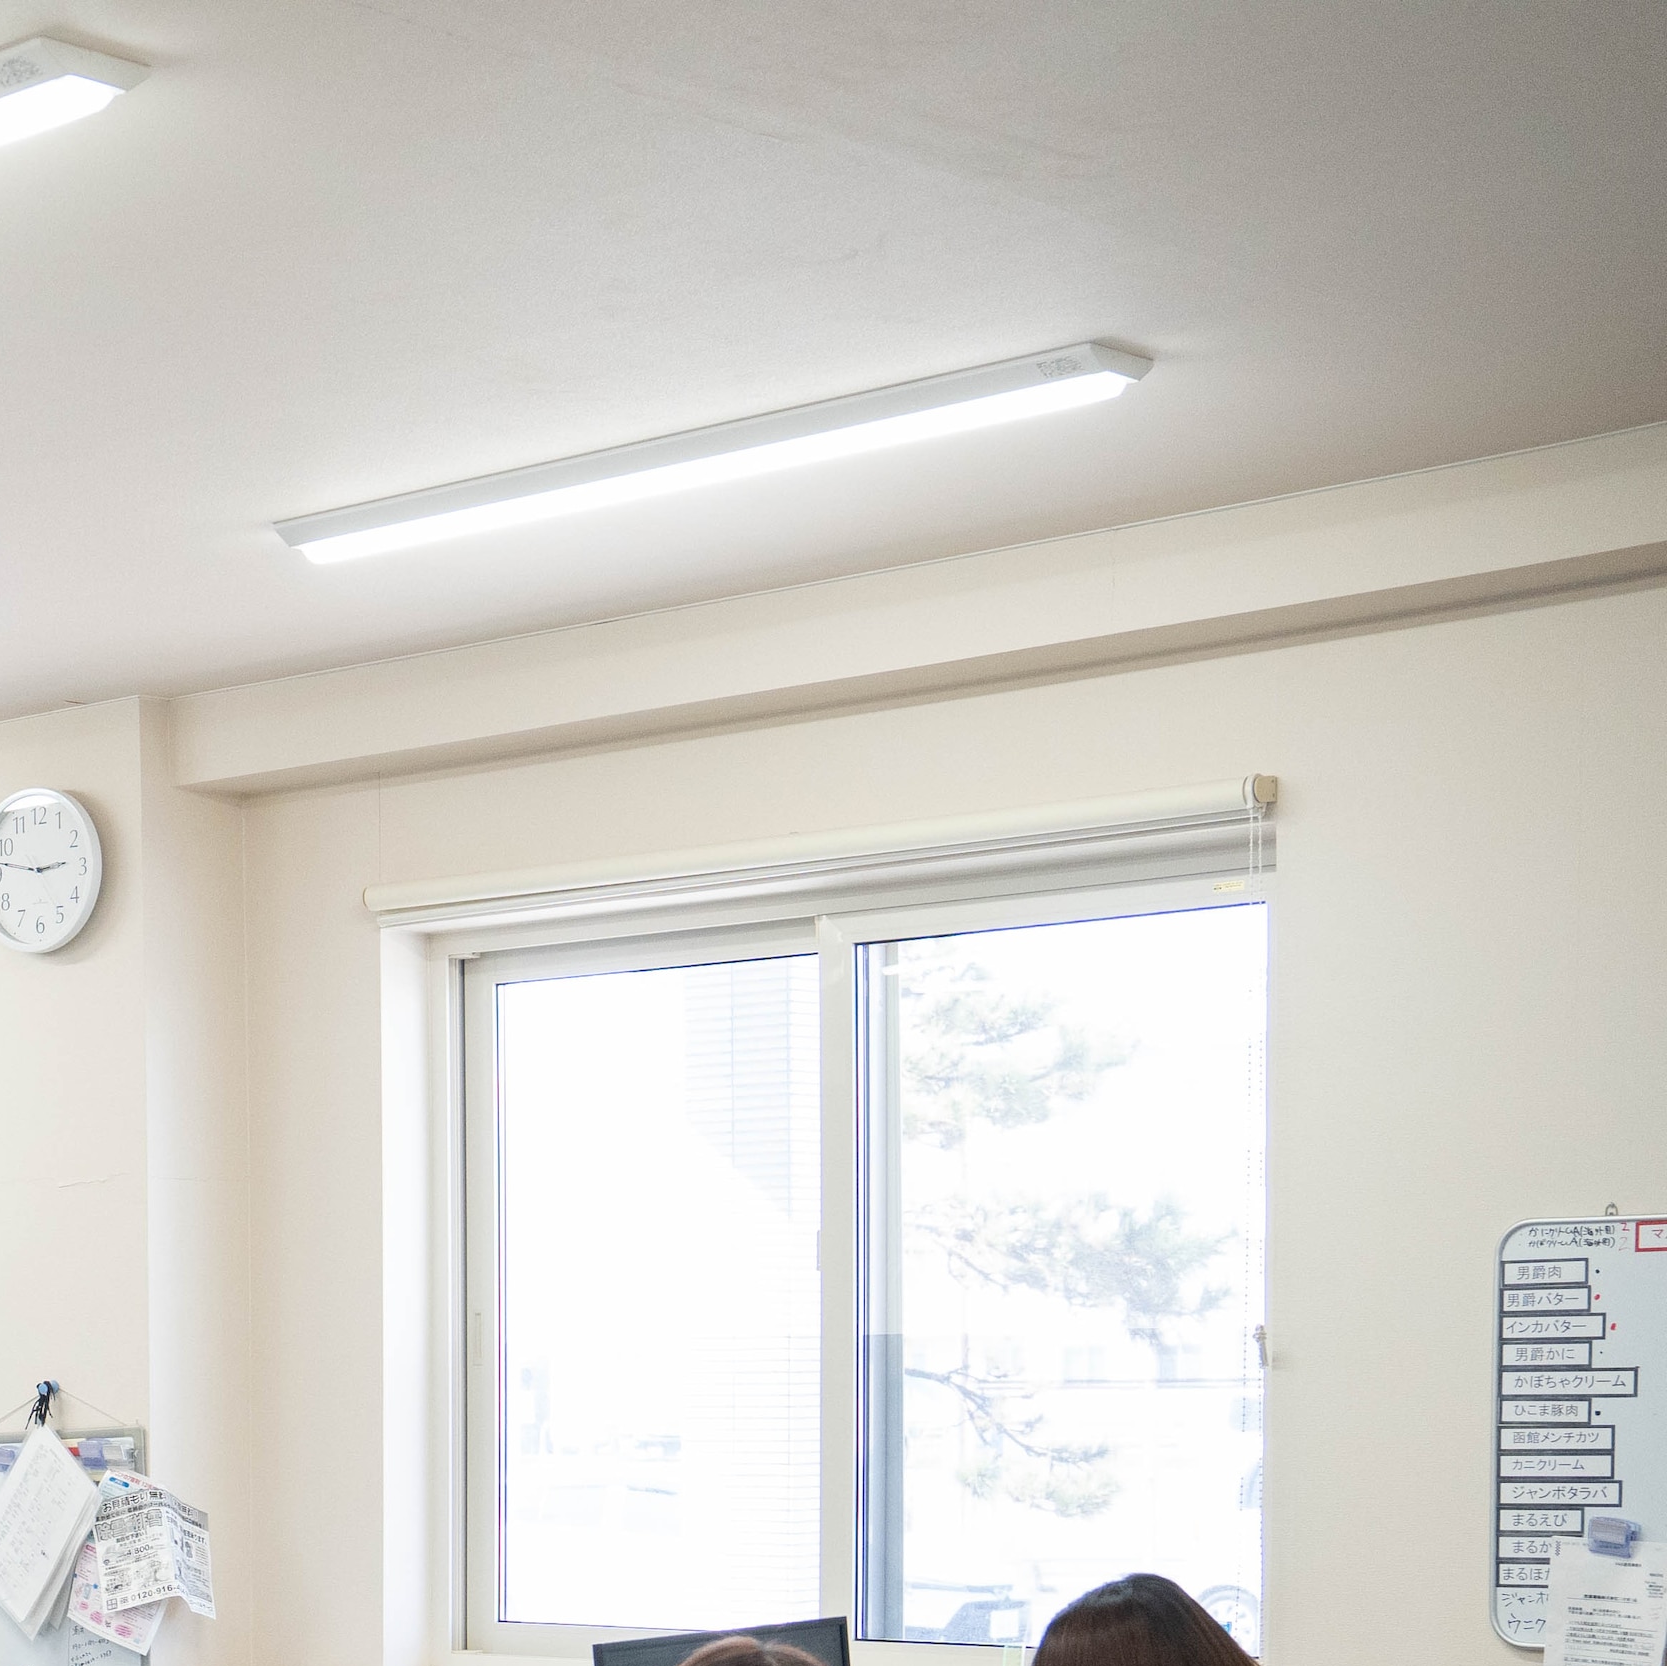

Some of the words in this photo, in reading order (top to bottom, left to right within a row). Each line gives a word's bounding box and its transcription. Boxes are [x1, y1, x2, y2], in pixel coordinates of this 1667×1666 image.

[31, 807, 47, 825] 12
[55, 812, 62, 829] 1
[13, 816, 26, 834] 11
[70, 830, 79, 848] 2
[79, 857, 87, 875] 3
[1, 893, 10, 911] 8
[70, 886, 80, 903] 4
[18, 910, 26, 927] 7
[56, 906, 64, 924] 5
[36, 916, 45, 934] 6
[1517, 1266, 1562, 1280] 男爵肉
[1507, 1293, 1579, 1307] 男爵バター
[1506, 1320, 1587, 1333] インカバター
[1515, 1348, 1575, 1361] 男爵かに
[1515, 1375, 1626, 1388] かぼちゃクリーム
[1513, 1432, 1600, 1444] 函館メンチカツ
[1512, 1460, 1585, 1471] カニクリーム
[1512, 1486, 1607, 1500] ジャンボタラバ
[1512, 1513, 1567, 1527] まるえび
